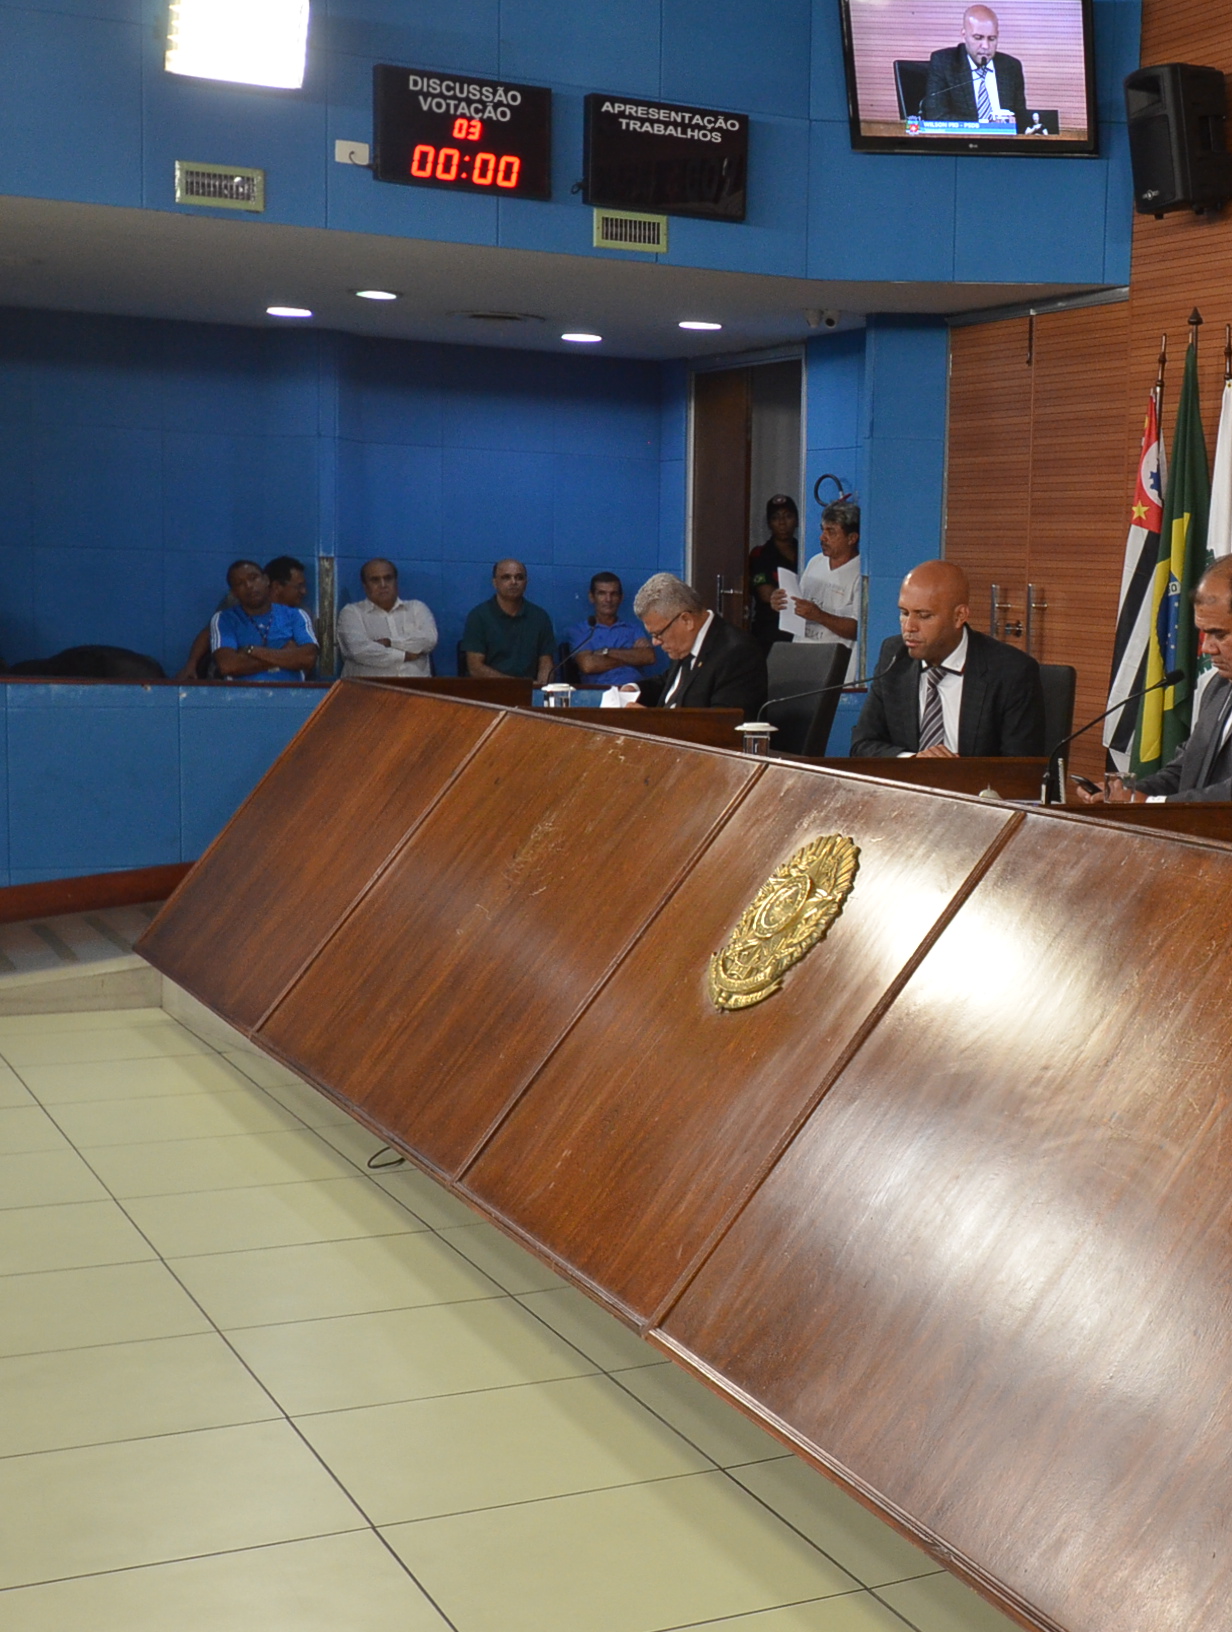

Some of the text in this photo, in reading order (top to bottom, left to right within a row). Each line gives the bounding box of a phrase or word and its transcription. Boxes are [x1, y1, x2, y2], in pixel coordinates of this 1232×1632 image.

[409, 75, 521, 106] DISCUSSÃO
[418, 96, 511, 121] VOTAÇÃO
[601, 101, 740, 131] APRESENTAÇÃO
[452, 118, 482, 141] 03
[619, 118, 722, 143] TRABALHOS
[410, 144, 520, 188] 00:00
